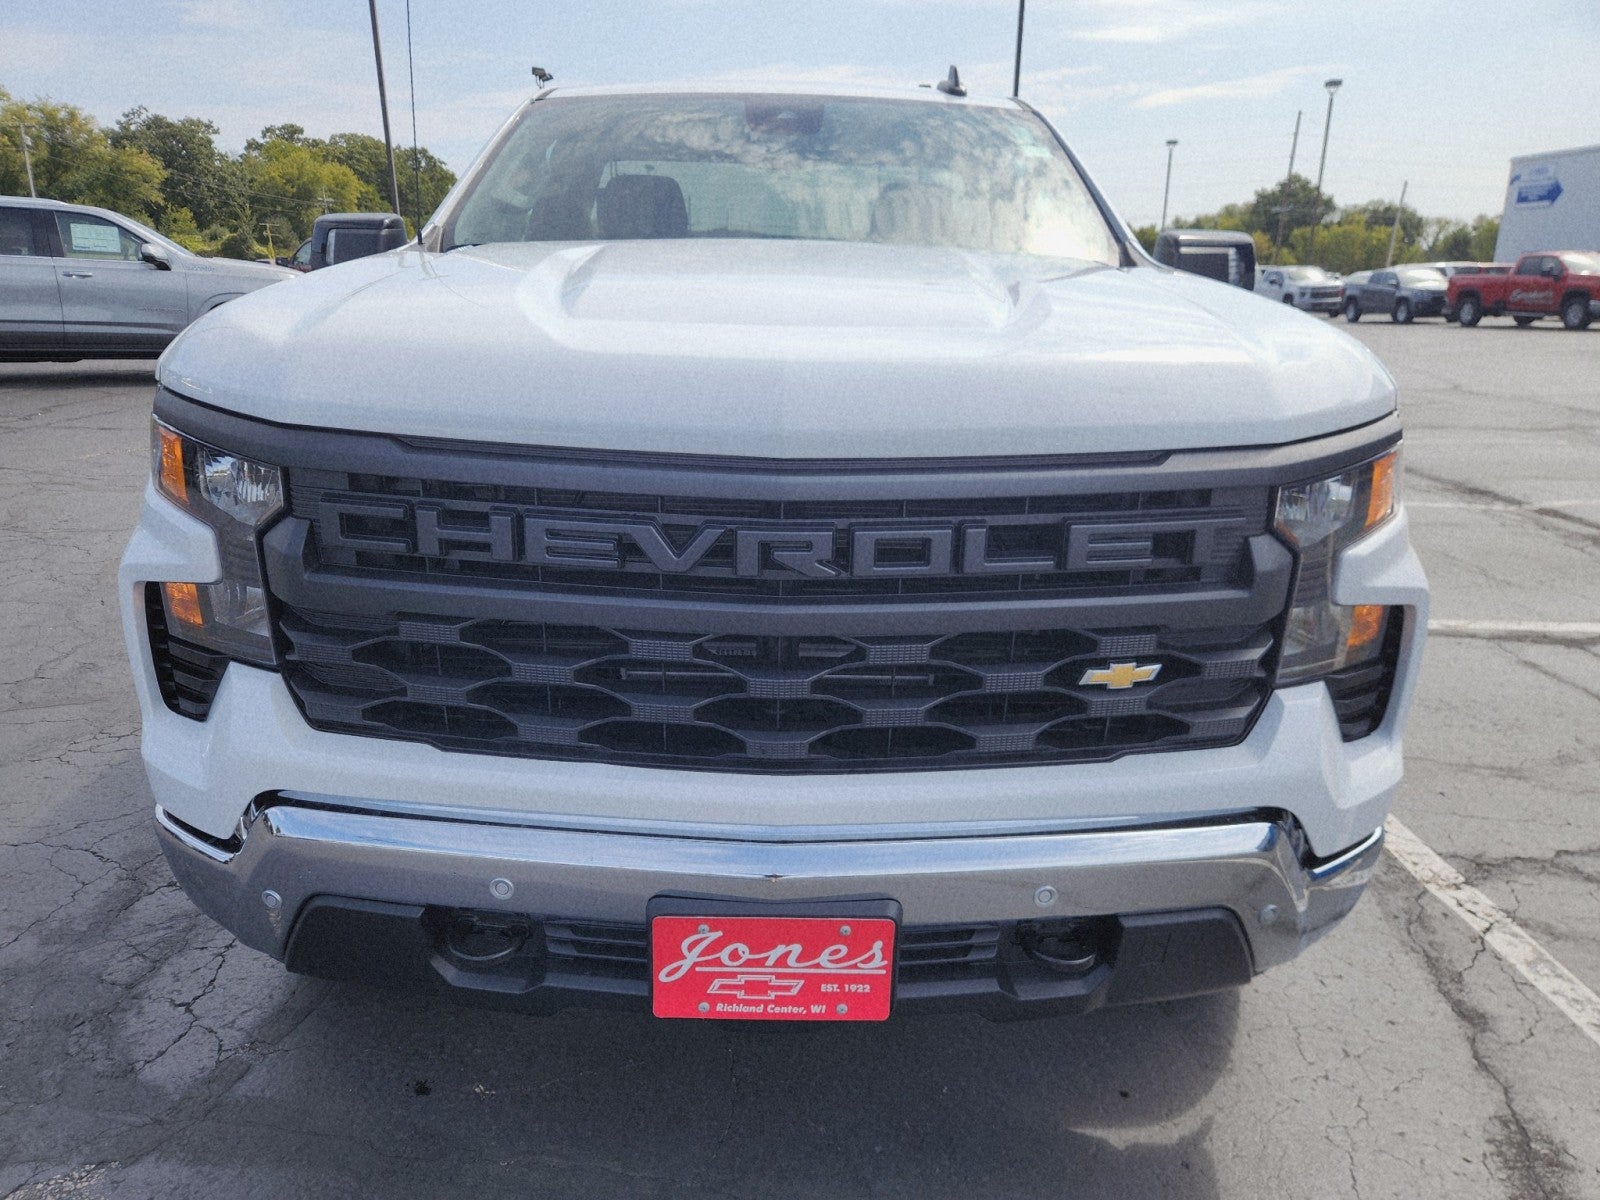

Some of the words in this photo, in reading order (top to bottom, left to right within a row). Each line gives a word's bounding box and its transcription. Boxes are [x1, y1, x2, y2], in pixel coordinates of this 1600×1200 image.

[318, 499, 1247, 578] CHEVROLET
[658, 930, 888, 983] Jones
[820, 983, 841, 993] EST.
[844, 983, 871, 993] 1922
[716, 1003, 764, 1014] Richland
[766, 1003, 808, 1015] Center,
[810, 1004, 826, 1014] WI
